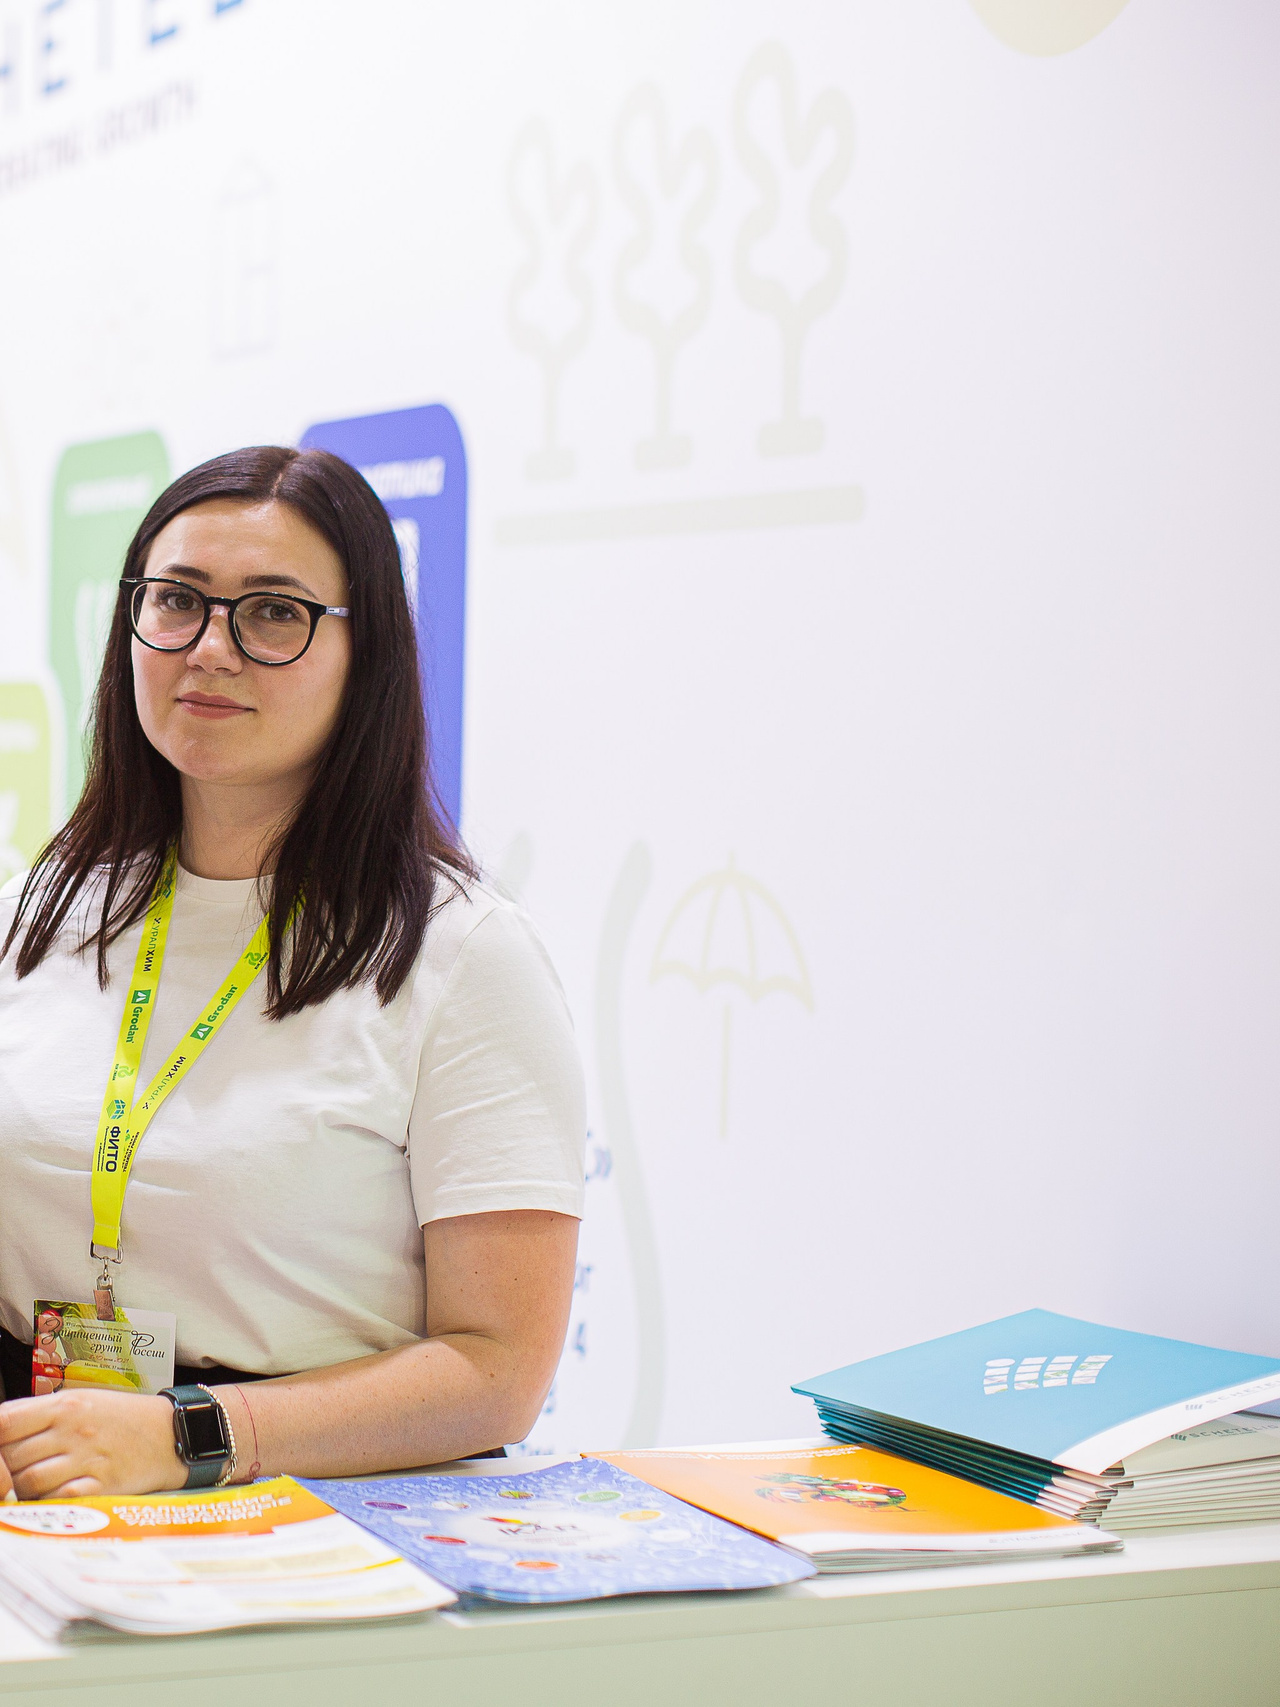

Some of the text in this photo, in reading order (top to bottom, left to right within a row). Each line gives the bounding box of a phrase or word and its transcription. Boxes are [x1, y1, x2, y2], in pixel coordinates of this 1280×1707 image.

[142, 924, 159, 972] УРАЛХИМ
[207, 985, 238, 1022] Grodan
[126, 1006, 143, 1043] Grodan
[148, 1056, 186, 1101] УРАЛХИМ
[105, 1126, 121, 1172] ФИТО
[41, 1317, 122, 1345] Защищенный
[90, 1342, 122, 1354] грунт
[130, 1330, 165, 1358] России
[1189, 1424, 1279, 1438] SCHETELIG
